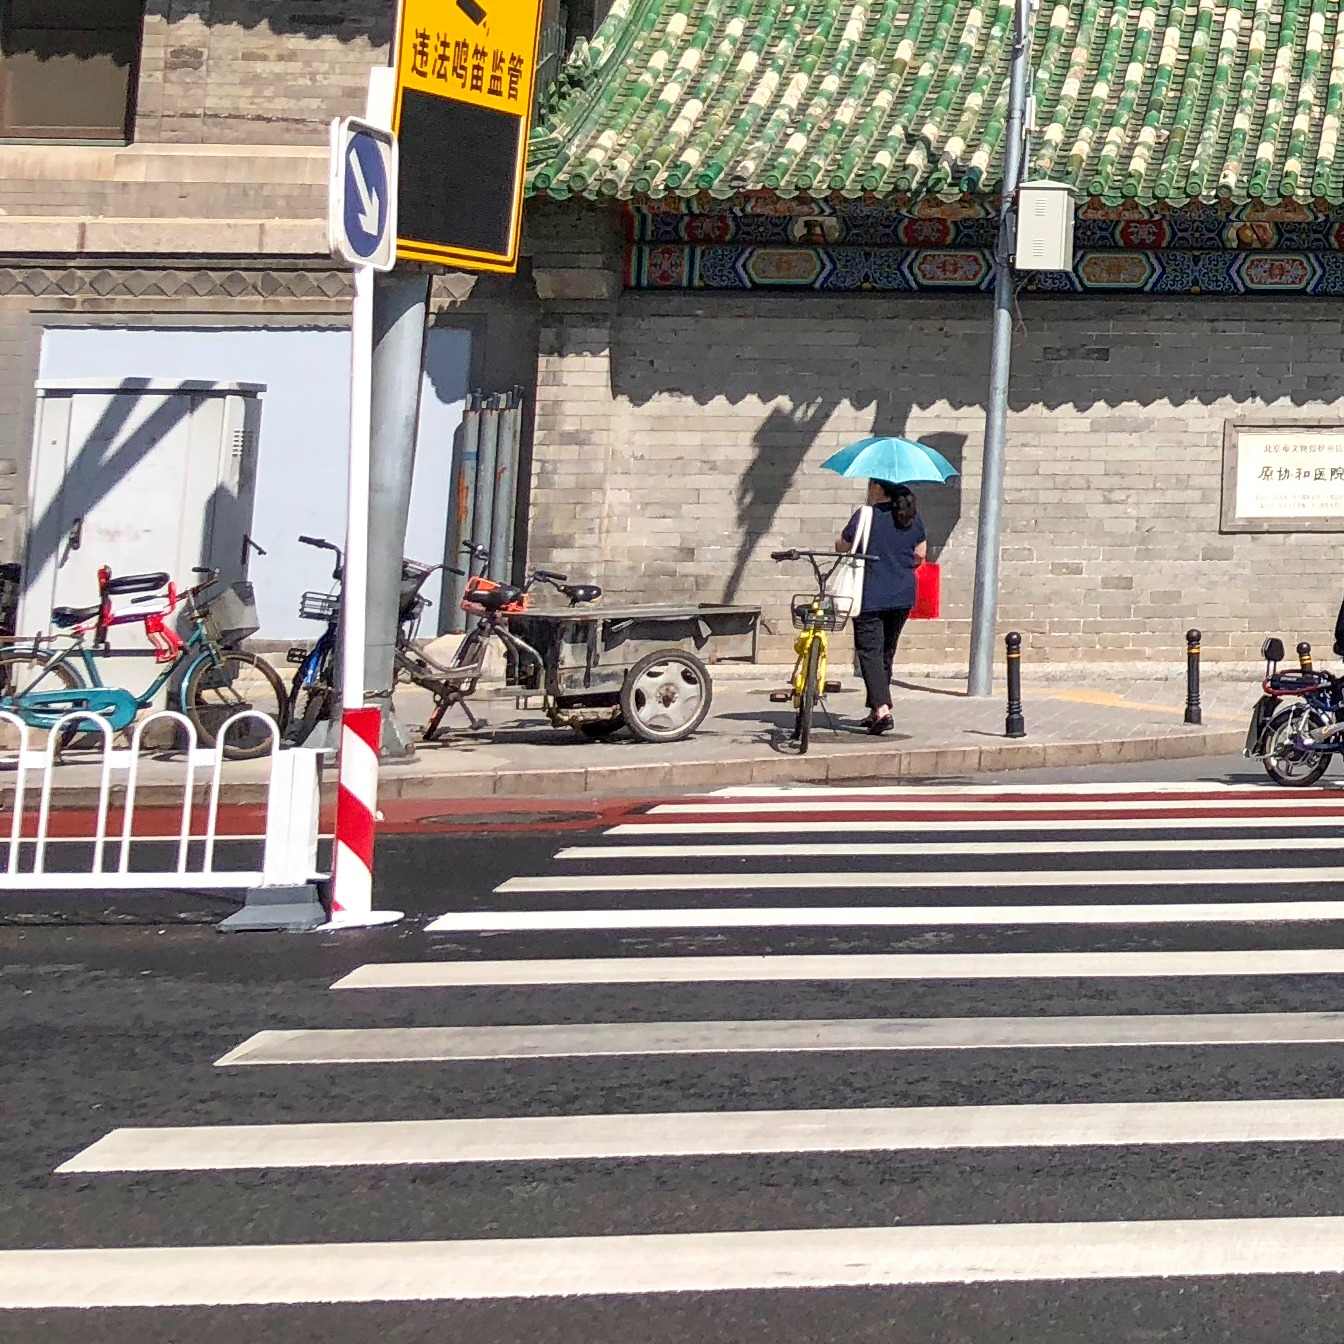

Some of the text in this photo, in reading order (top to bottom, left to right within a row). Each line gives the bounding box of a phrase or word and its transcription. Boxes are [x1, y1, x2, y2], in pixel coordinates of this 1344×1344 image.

[411, 28, 525, 102] 违法鸣笛监管
[1264, 444, 1344, 453] 北京市文物保护单位
